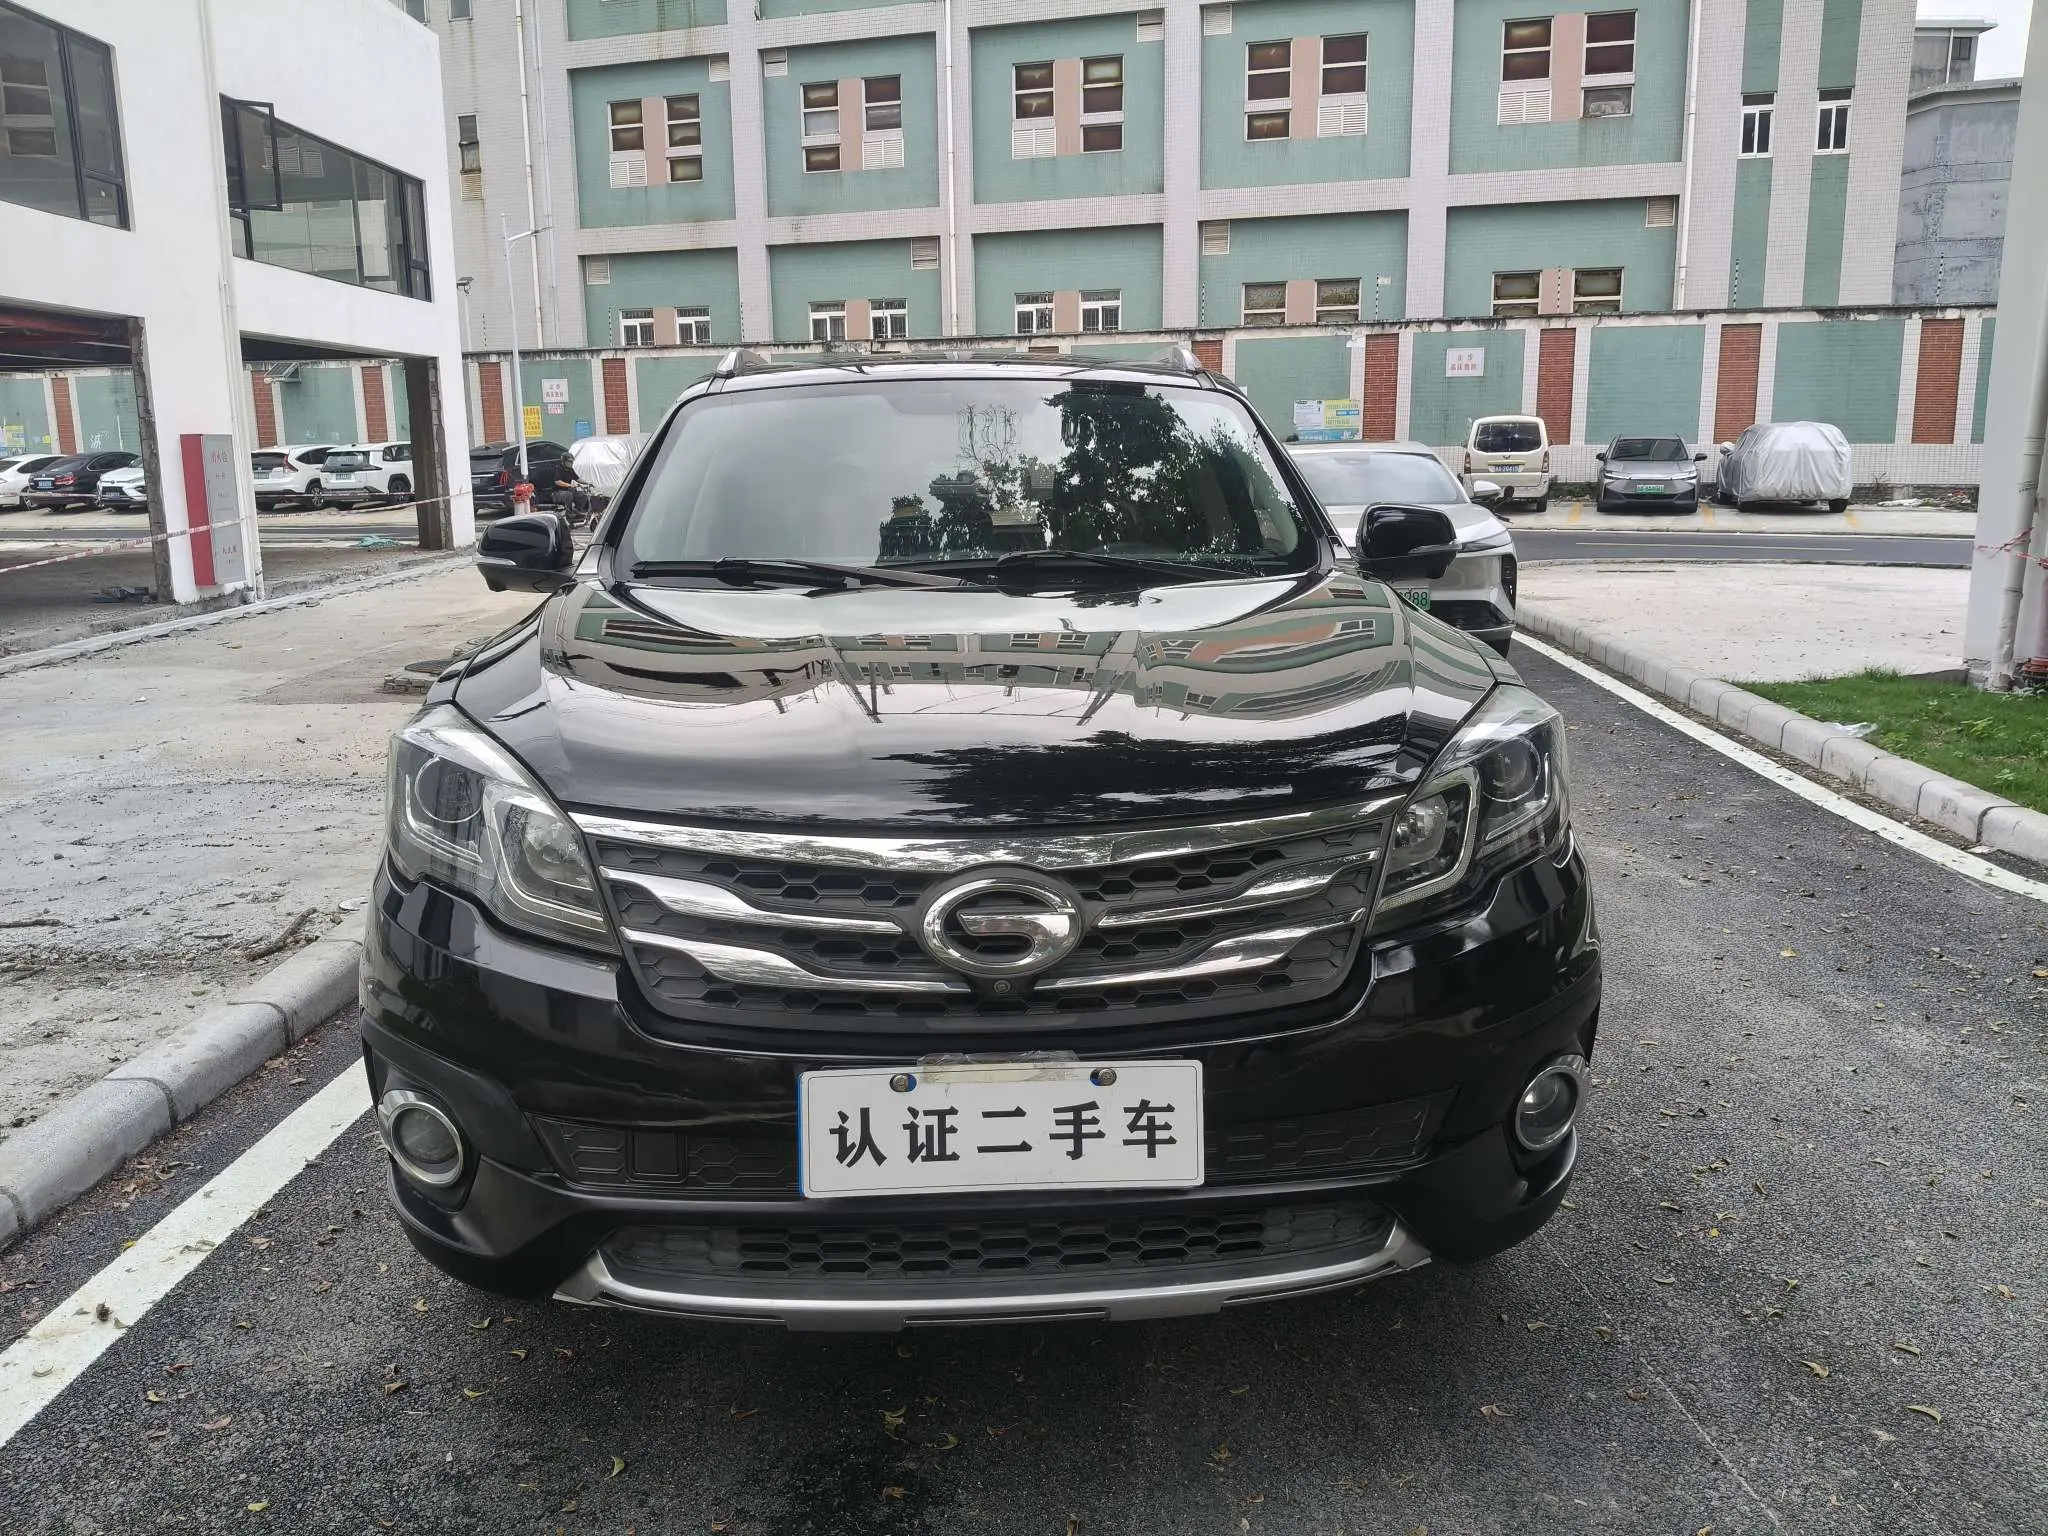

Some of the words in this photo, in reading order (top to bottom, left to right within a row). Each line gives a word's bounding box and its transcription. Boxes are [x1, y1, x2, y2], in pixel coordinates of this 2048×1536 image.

[829, 1098, 1178, 1168] 认证二手车
